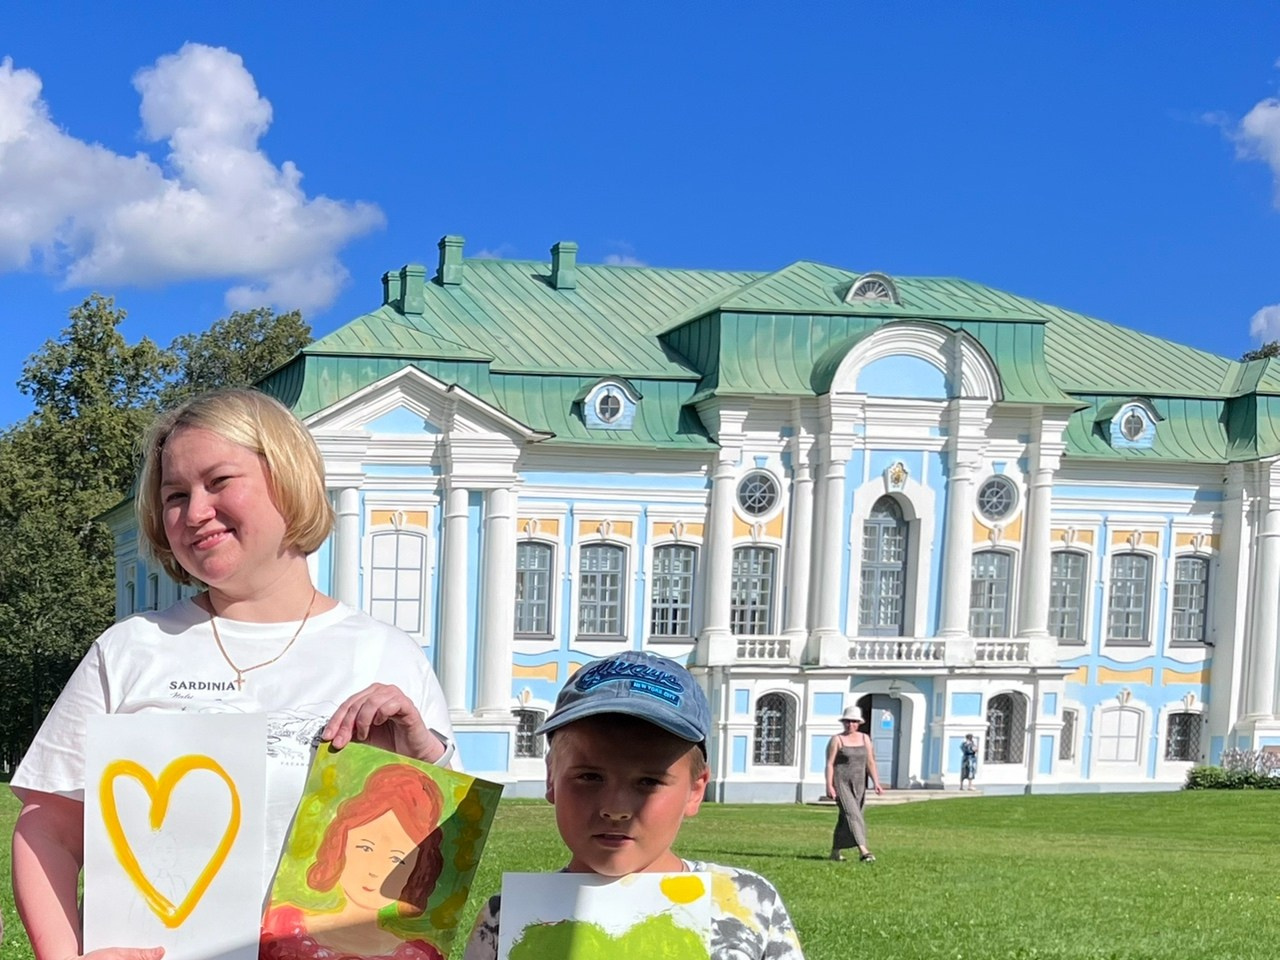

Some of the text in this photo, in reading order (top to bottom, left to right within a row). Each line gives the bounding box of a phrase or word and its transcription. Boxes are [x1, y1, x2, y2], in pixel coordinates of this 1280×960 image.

[169, 681, 236, 691] SARDINIA
[633, 682, 677, 700] NEW YORK CITY
